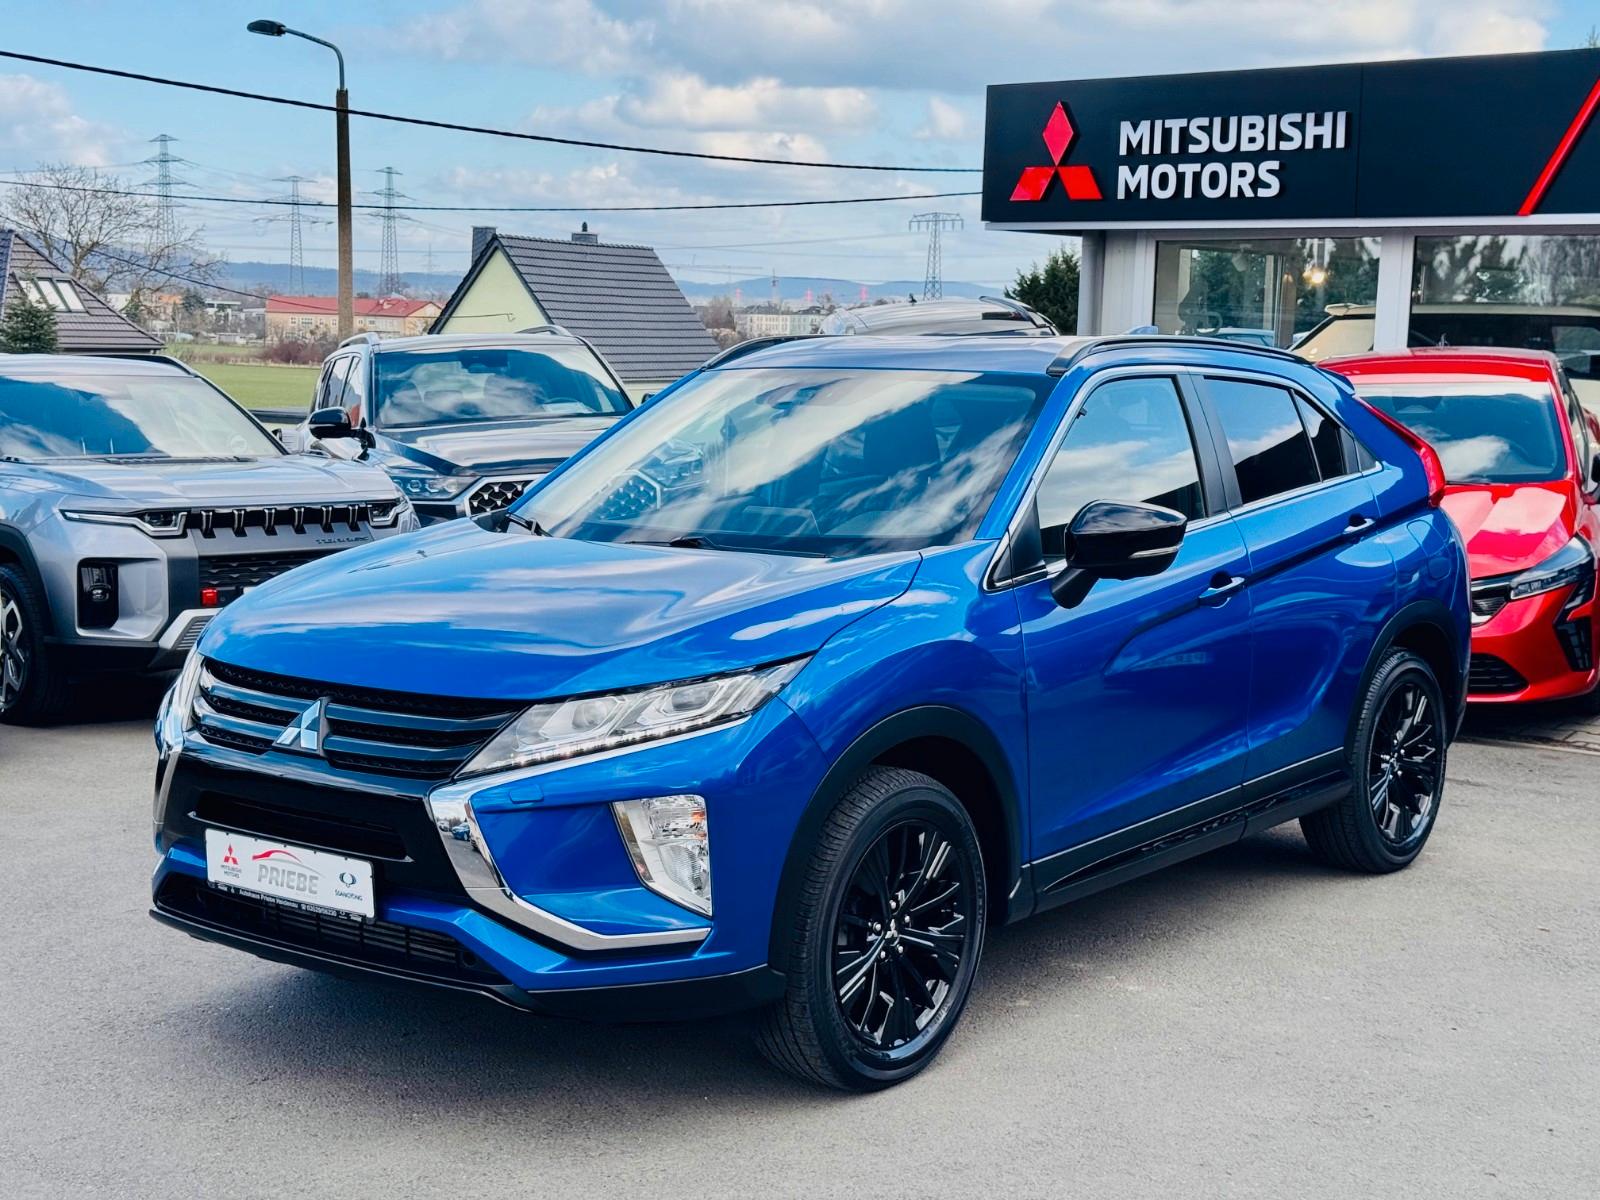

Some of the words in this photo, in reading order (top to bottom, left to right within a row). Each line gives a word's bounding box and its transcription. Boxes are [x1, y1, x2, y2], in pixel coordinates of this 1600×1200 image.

[1118, 110, 1348, 156] MITSUBISHI
[1117, 160, 1281, 200] MOTORS
[257, 864, 319, 895] PRIEBE
